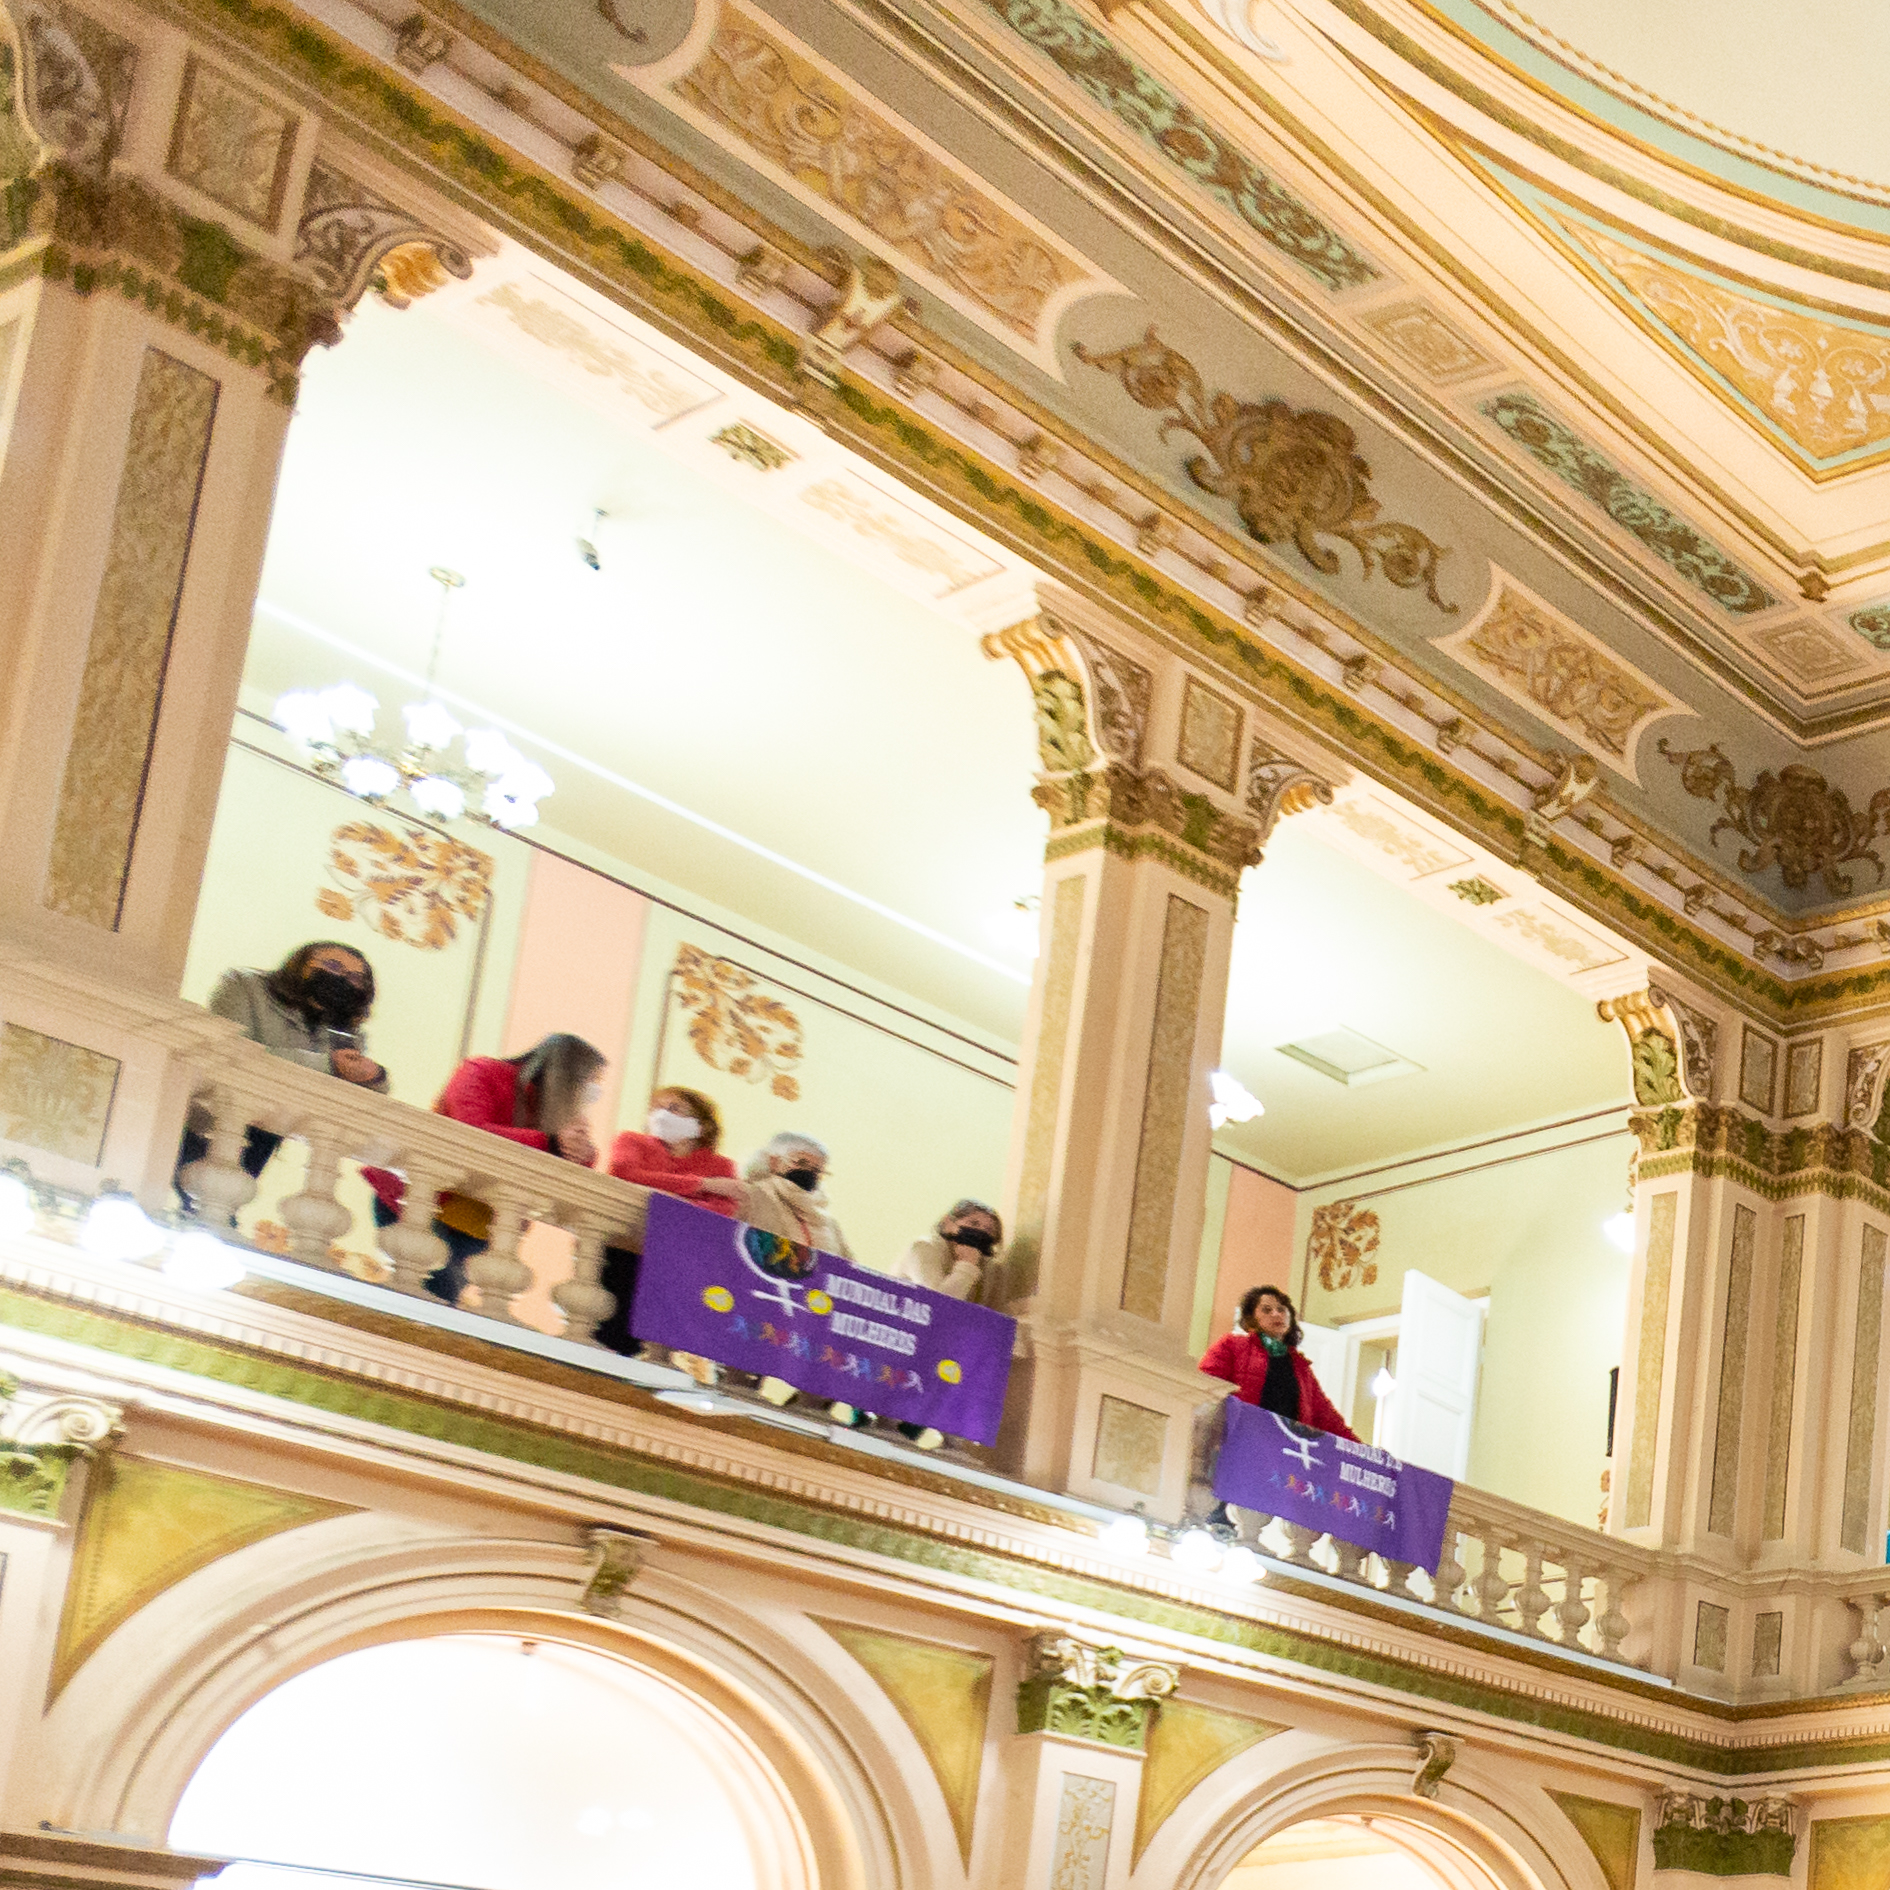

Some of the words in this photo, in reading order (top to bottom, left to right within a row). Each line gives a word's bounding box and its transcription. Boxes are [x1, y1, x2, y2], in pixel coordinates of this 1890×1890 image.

[826, 1273, 898, 1316] MUNDIAL
[902, 1297, 931, 1326] DAS
[831, 1310, 917, 1355] MULHERES
[1339, 1461, 1398, 1498] MULHERES
